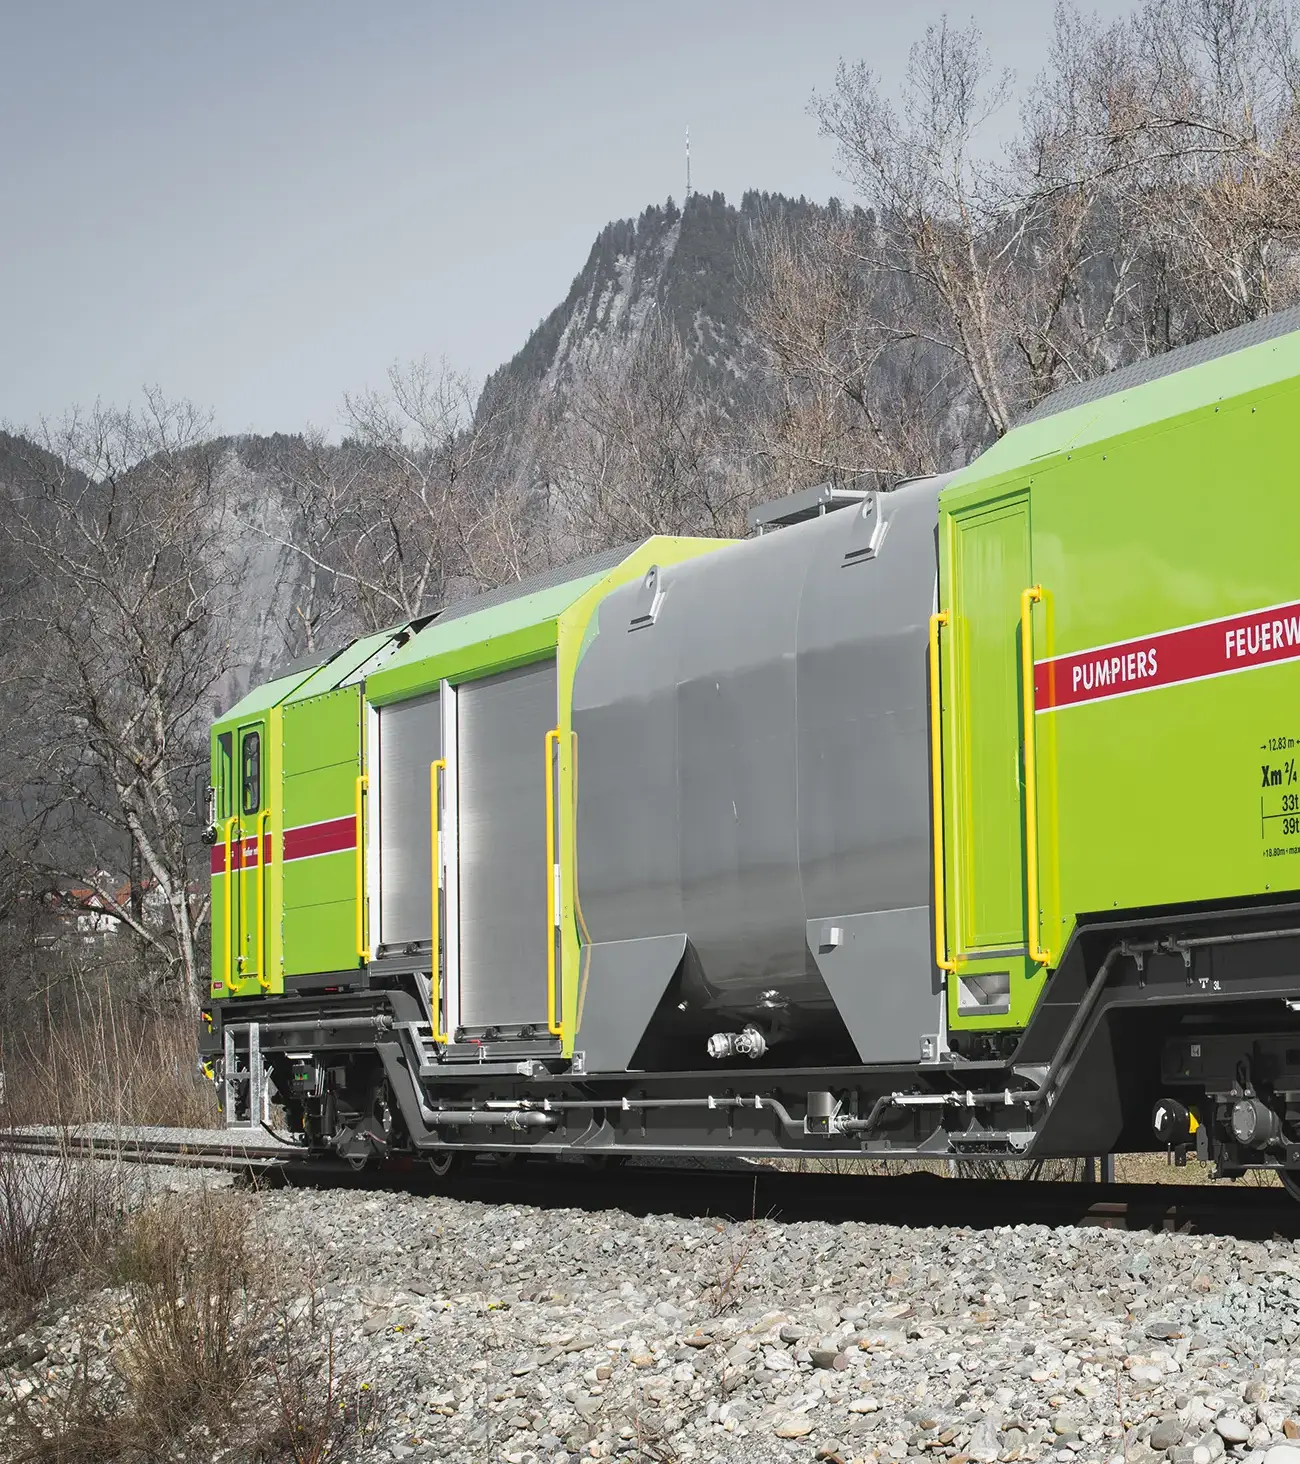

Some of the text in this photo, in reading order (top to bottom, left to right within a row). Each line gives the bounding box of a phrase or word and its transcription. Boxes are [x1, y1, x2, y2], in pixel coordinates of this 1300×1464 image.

[1072, 648, 1158, 692] PUMPIERS
[1268, 737, 1295, 751] 12.83 m
[1282, 794, 1299, 811] 33t
[1282, 817, 1300, 834] 39t
